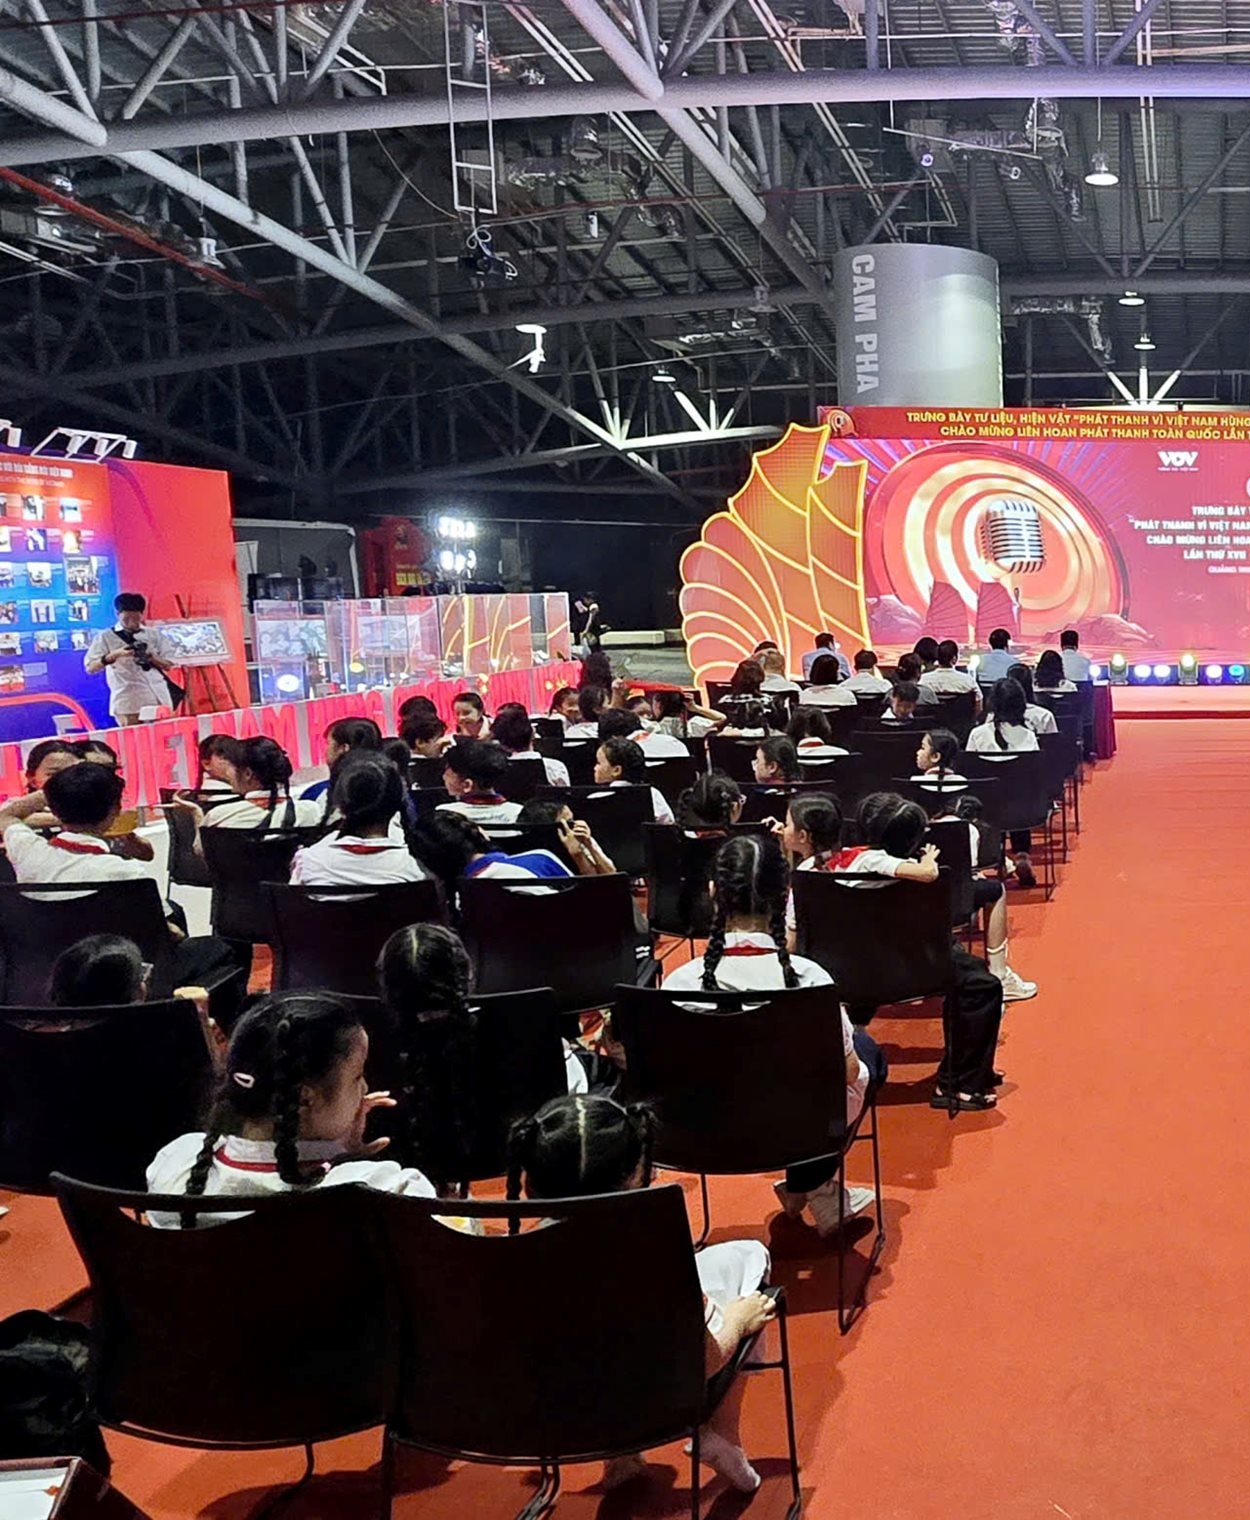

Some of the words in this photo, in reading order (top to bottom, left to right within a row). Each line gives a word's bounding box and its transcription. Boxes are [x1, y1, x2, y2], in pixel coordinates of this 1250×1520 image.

[852, 254, 876, 323] CAM
[854, 333, 880, 394] PHA
[1111, 415, 1149, 425] THANH
[1192, 417, 1217, 427] NAM
[940, 425, 976, 436] CHÀO
[979, 425, 1014, 437] MỪNG
[1017, 426, 1040, 437] LIÊN
[1043, 427, 1077, 437] HOAN
[1080, 426, 1109, 437] PHÁT
[1111, 428, 1149, 438] THANH
[1152, 428, 1184, 439] TOÀN
[1157, 451, 1199, 467] VOV
